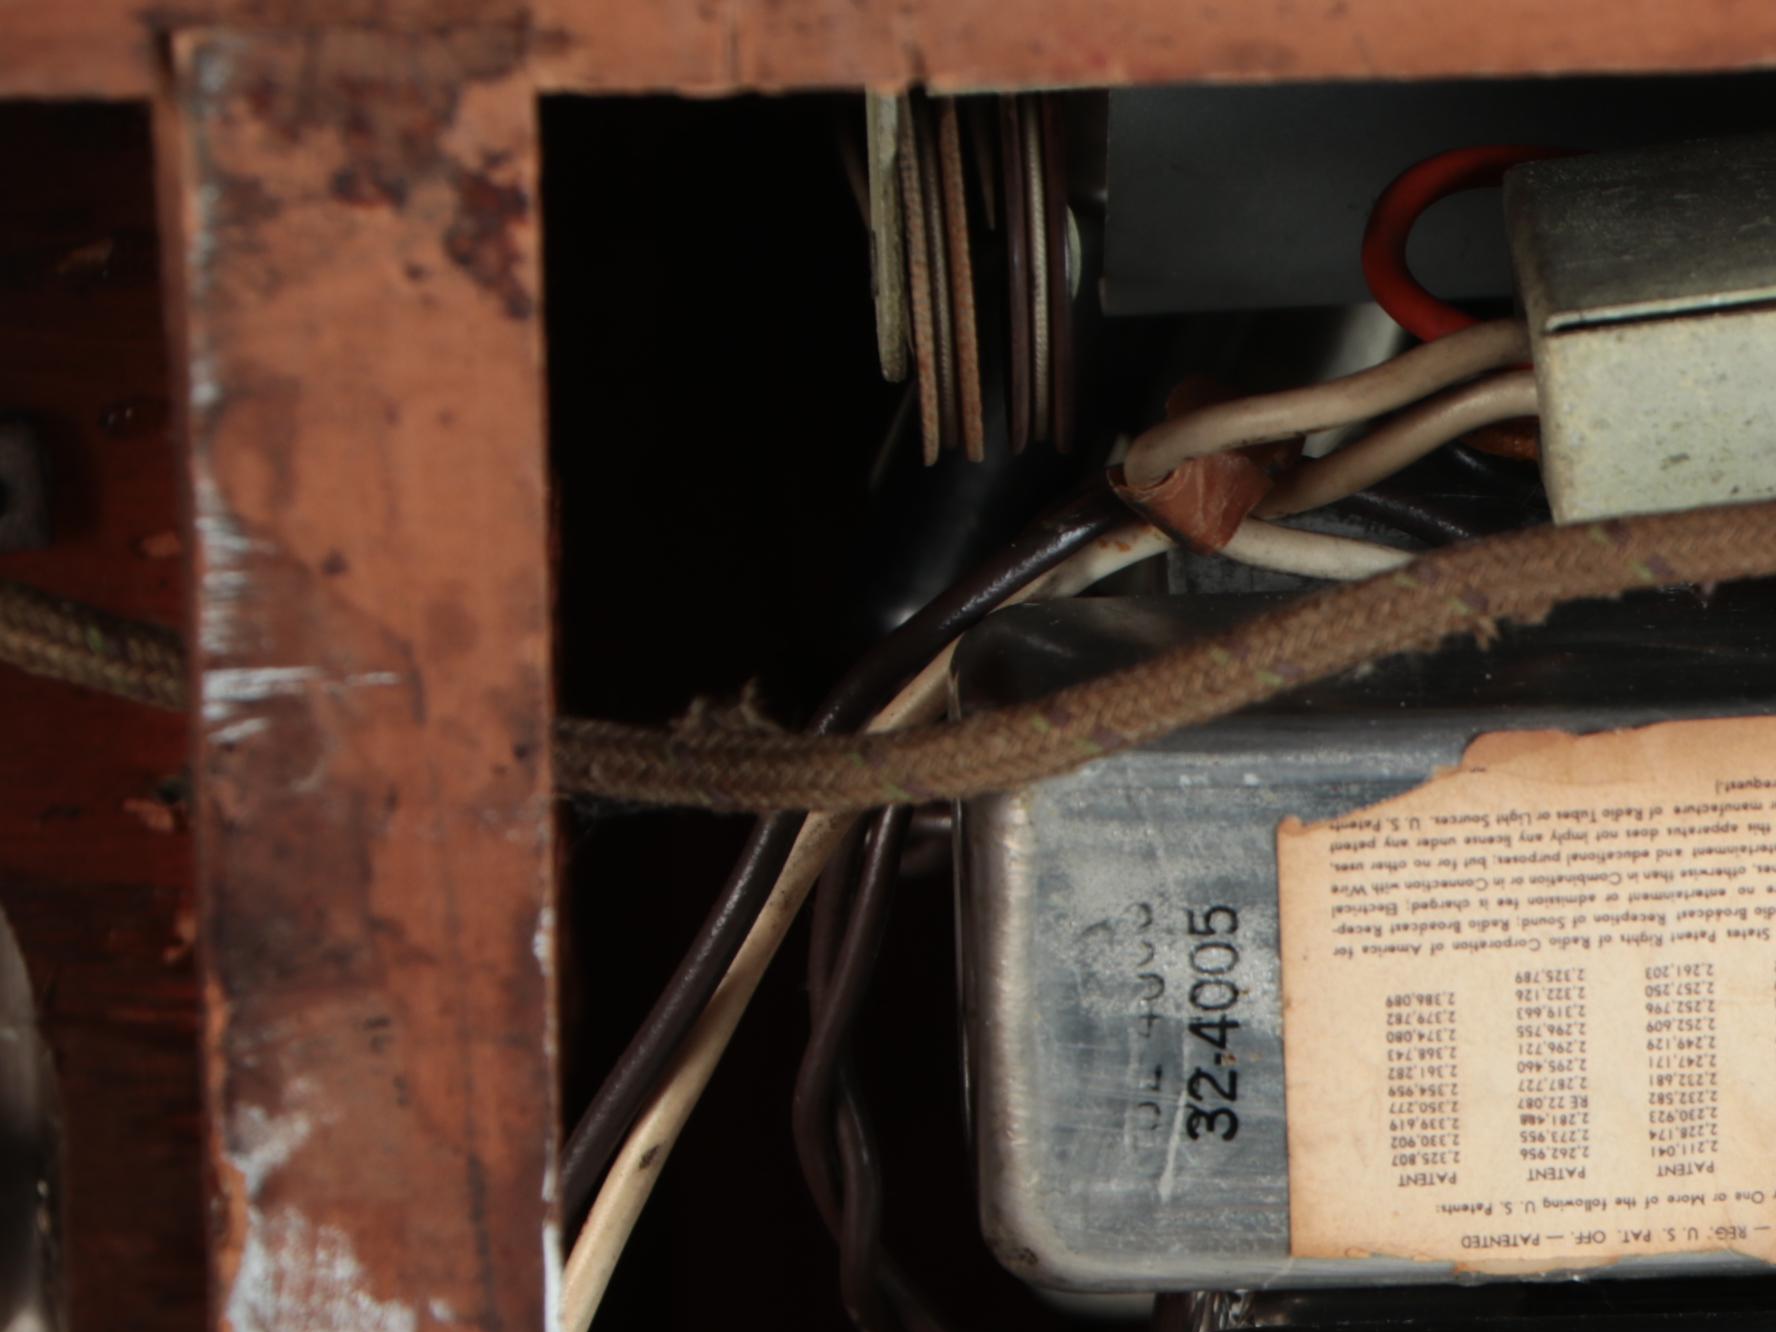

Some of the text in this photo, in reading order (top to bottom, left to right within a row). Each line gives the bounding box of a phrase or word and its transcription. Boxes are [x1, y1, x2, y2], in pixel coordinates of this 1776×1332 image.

[1536, 812, 1551, 821] or
[1556, 810, 1597, 824] Tubes
[1602, 807, 1644, 823] Radio
[1649, 806, 1663, 821] of
[1673, 802, 1763, 818] manufacture
[1495, 809, 1532, 827] Light
[1518, 830, 1544, 843] any
[1595, 830, 1619, 843] not
[1625, 828, 1659, 842] does
[1666, 822, 1739, 839] apparatus
[1747, 823, 1772, 836] this
[1384, 836, 1409, 849] any
[1416, 837, 1457, 851] under
[1463, 835, 1512, 848] license
[1550, 828, 1589, 846] imply
[1329, 837, 1377, 855] patent
[1566, 849, 1650, 867] educational
[1656, 849, 1683, 863] and
[1370, 860, 1407, 874] other
[1413, 860, 1432, 868] no
[1437, 859, 1458, 872] for
[1463, 857, 1488, 870] but
[1529, 872, 1623, 888] Combination
[1627, 872, 1639, 884] in
[1643, 870, 1675, 884] than
[1680, 866, 1747, 881] otherwise
[1404, 878, 1490, 893] Connection
[1493, 878, 1506, 890] in
[1510, 876, 1525, 886] or
[1330, 885, 1368, 898] Wire
[1371, 882, 1400, 896] with
[1737, 886, 1755, 896] no
[1496, 897, 1520, 911] fee
[1527, 894, 1596, 909] admission
[1605, 893, 1620, 903] or
[1627, 889, 1727, 905] entertainment
[1331, 903, 1398, 919] Electrical
[1478, 898, 1490, 911] is
[1571, 915, 1587, 929] of
[1593, 910, 1666, 926] Reception
[1676, 907, 1748, 923] Broadcast
[1332, 923, 1383, 938] Recep-
[1389, 920, 1462, 936] Broadcast
[1468, 919, 1510, 933] Radio
[1598, 935, 1613, 949] of
[1620, 931, 1663, 948] Rights
[1670, 930, 1717, 944] Patent
[1726, 928, 1770, 942] States
[1430, 943, 1445, 957] of
[1452, 936, 1541, 955] Corporation
[1548, 936, 1591, 951] Radio
[1333, 947, 1354, 960] for
[1361, 944, 1422, 958] America
[1185, 905, 1240, 1142] 32-4005
[1648, 1090, 1718, 1105] 2,232,582
[1649, 1107, 1718, 1123] 2,230,923
[1390, 1133, 1460, 1151] 2,330,902
[1519, 1129, 1589, 1144] 2,273,955
[1519, 1145, 1589, 1161] 2,262,956
[1651, 1140, 1718, 1157] 2,211,041
[1391, 1150, 1460, 1167] 2,325,807
[1527, 1166, 1586, 1182] PATENT
[1656, 1161, 1715, 1177] PATENT
[1397, 1172, 1458, 1188] PATENT
[1614, 1197, 1637, 1210] the
[1645, 1196, 1659, 1210] of
[1667, 1194, 1705, 1206] More
[1712, 1193, 1728, 1202] or
[1734, 1191, 1766, 1205] One
[1542, 1197, 1607, 1213] following
[1461, 1233, 1540, 1250] PATENTED
